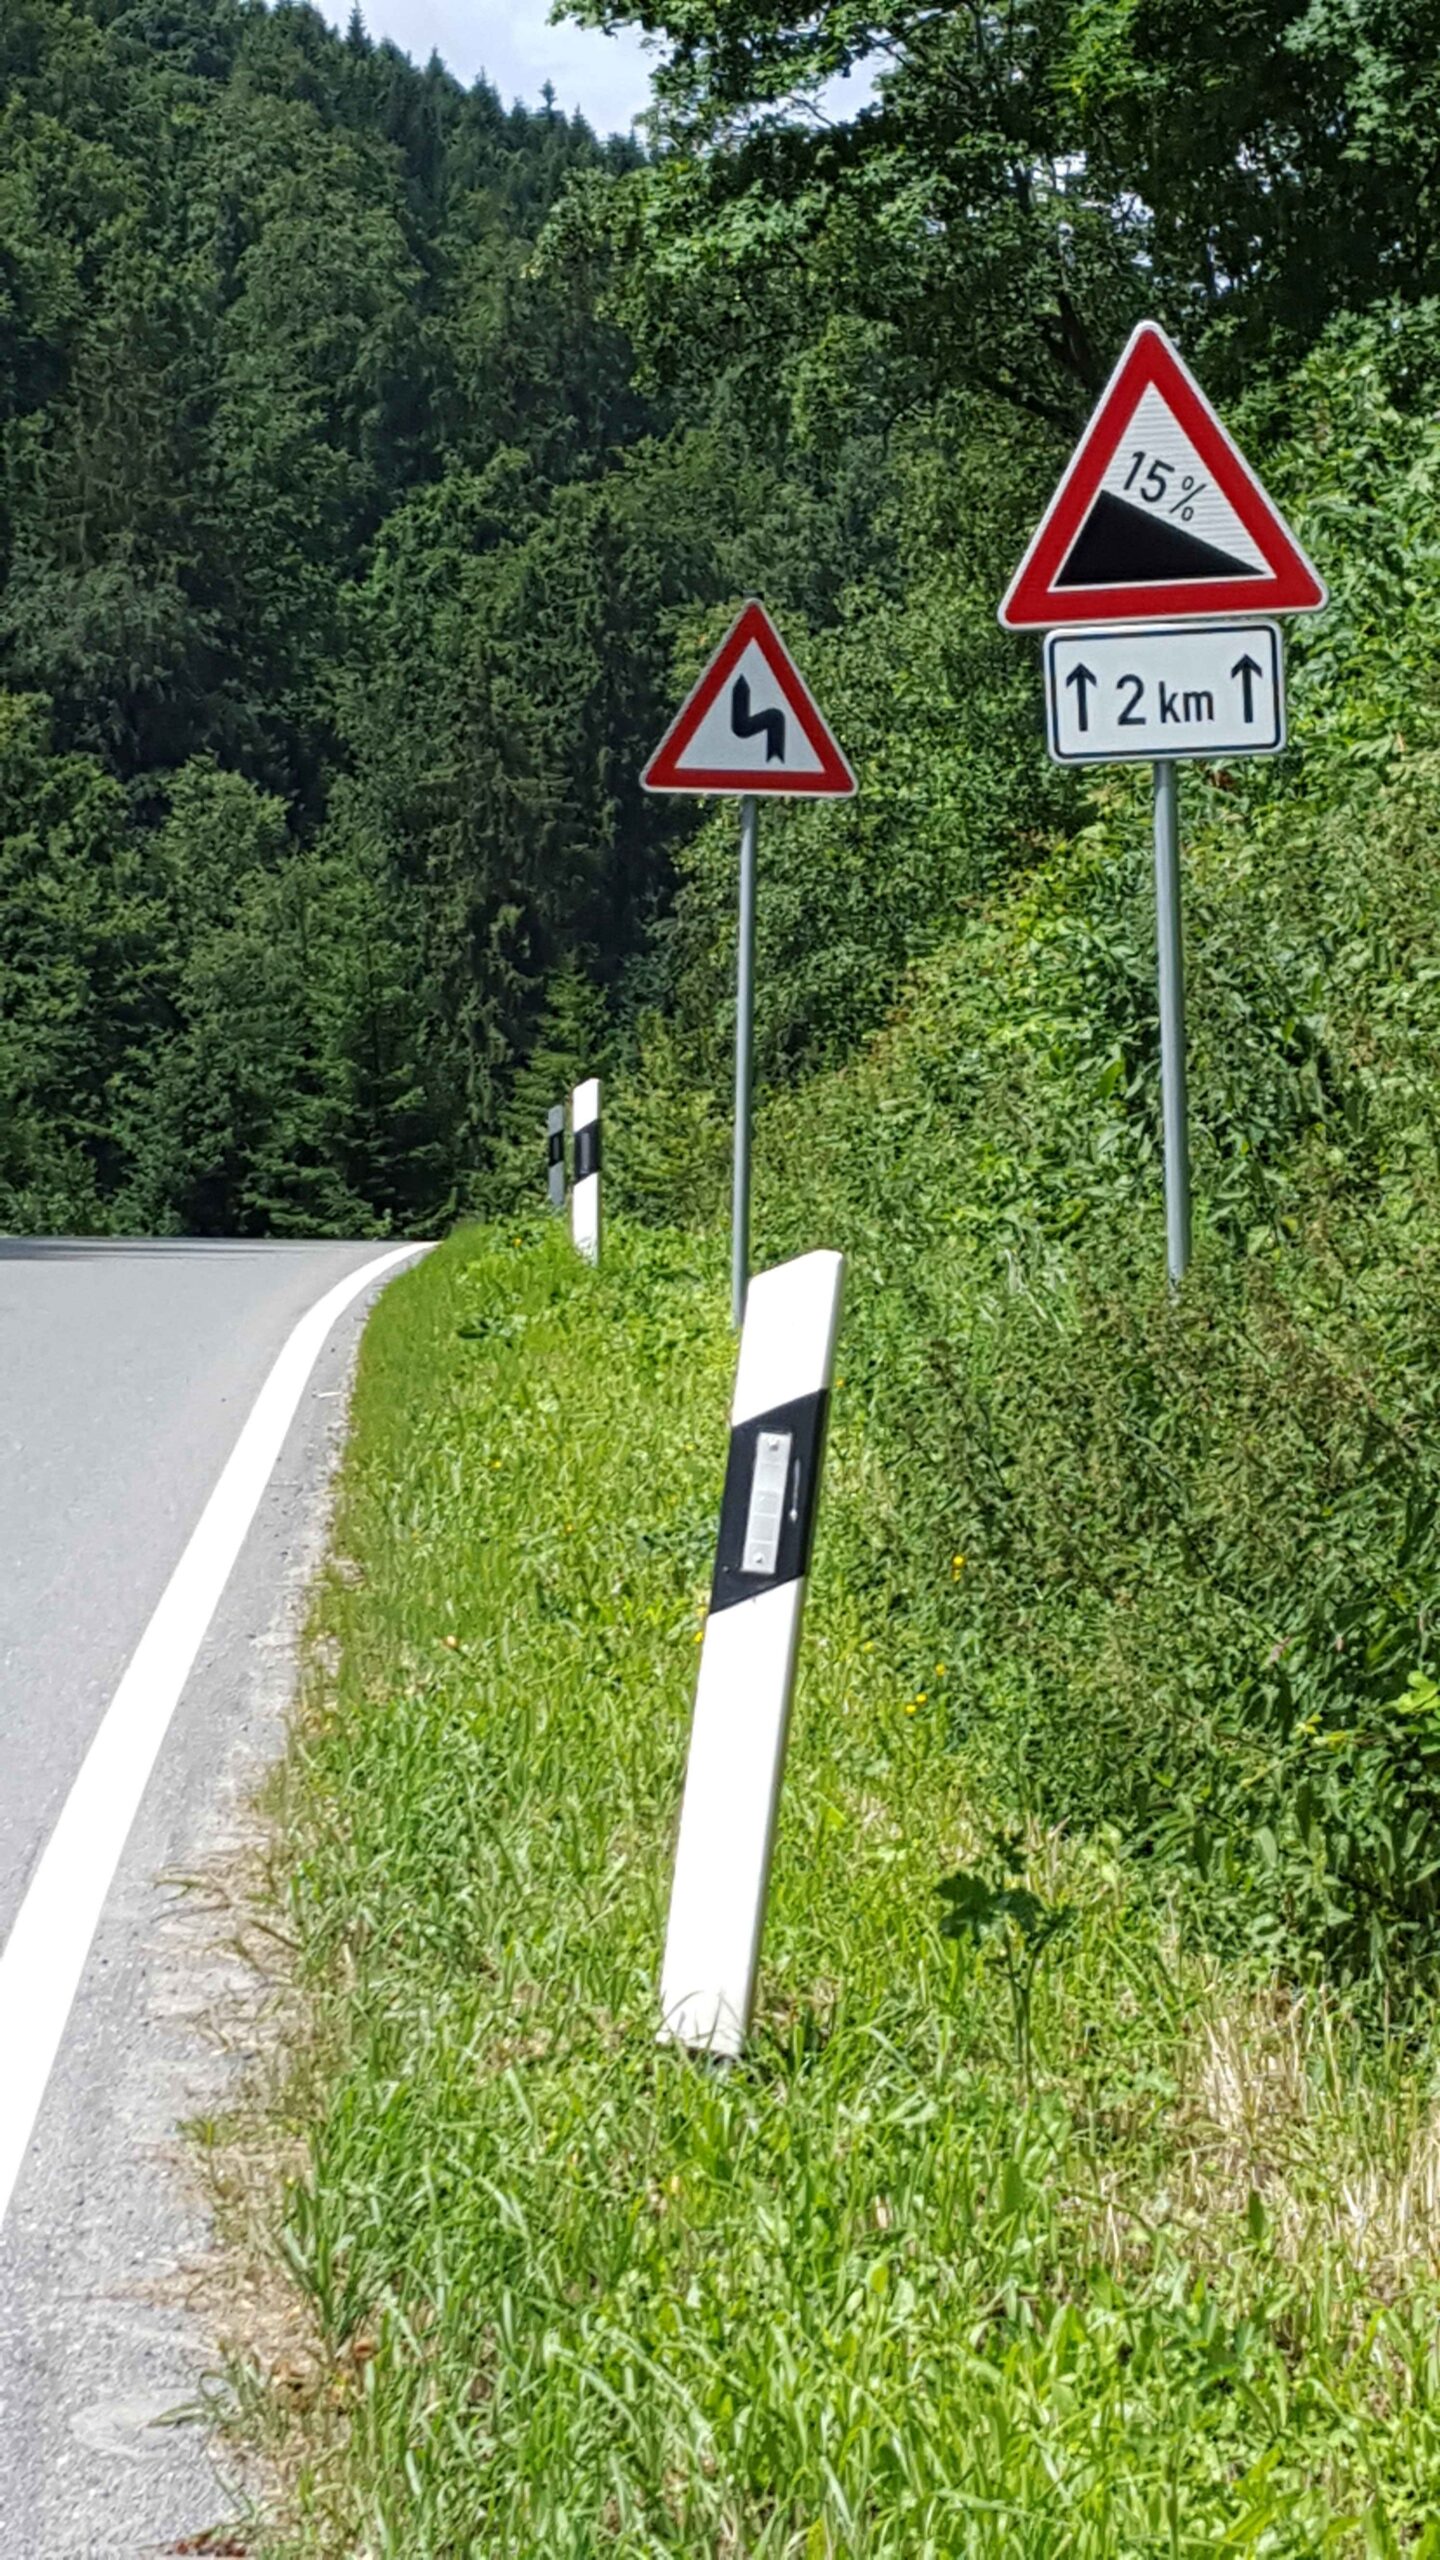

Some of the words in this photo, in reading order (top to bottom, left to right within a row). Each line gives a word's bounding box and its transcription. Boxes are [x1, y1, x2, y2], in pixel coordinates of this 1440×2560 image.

[1123, 451, 1207, 521] 15%
[1116, 674, 1146, 725] 2
[1159, 681, 1214, 724] km
